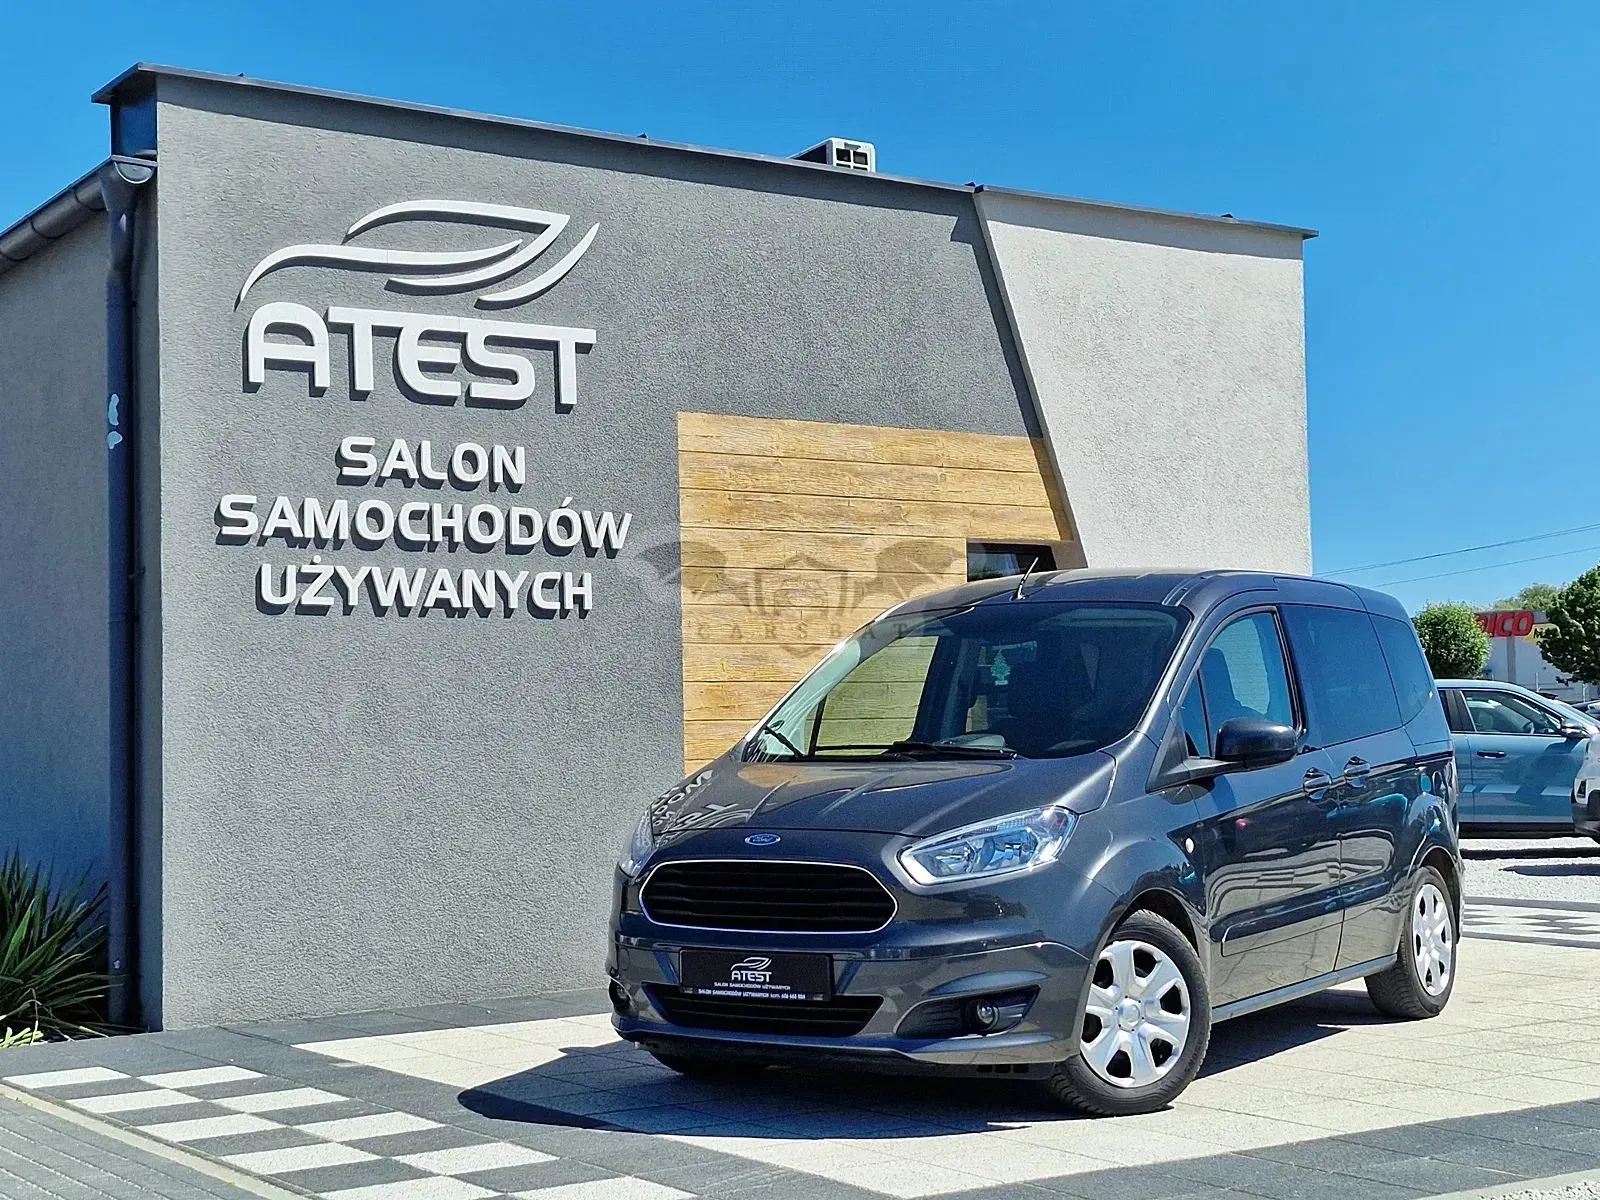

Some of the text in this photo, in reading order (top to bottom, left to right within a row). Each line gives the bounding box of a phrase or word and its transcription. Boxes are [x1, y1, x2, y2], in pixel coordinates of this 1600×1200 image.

[247, 301, 597, 405] ATEST
[339, 436, 526, 485] SALON
[217, 494, 632, 550] SAMOCHODÓW
[258, 555, 593, 611] UŻYWANYCH
[731, 971, 772, 982] ATEST
